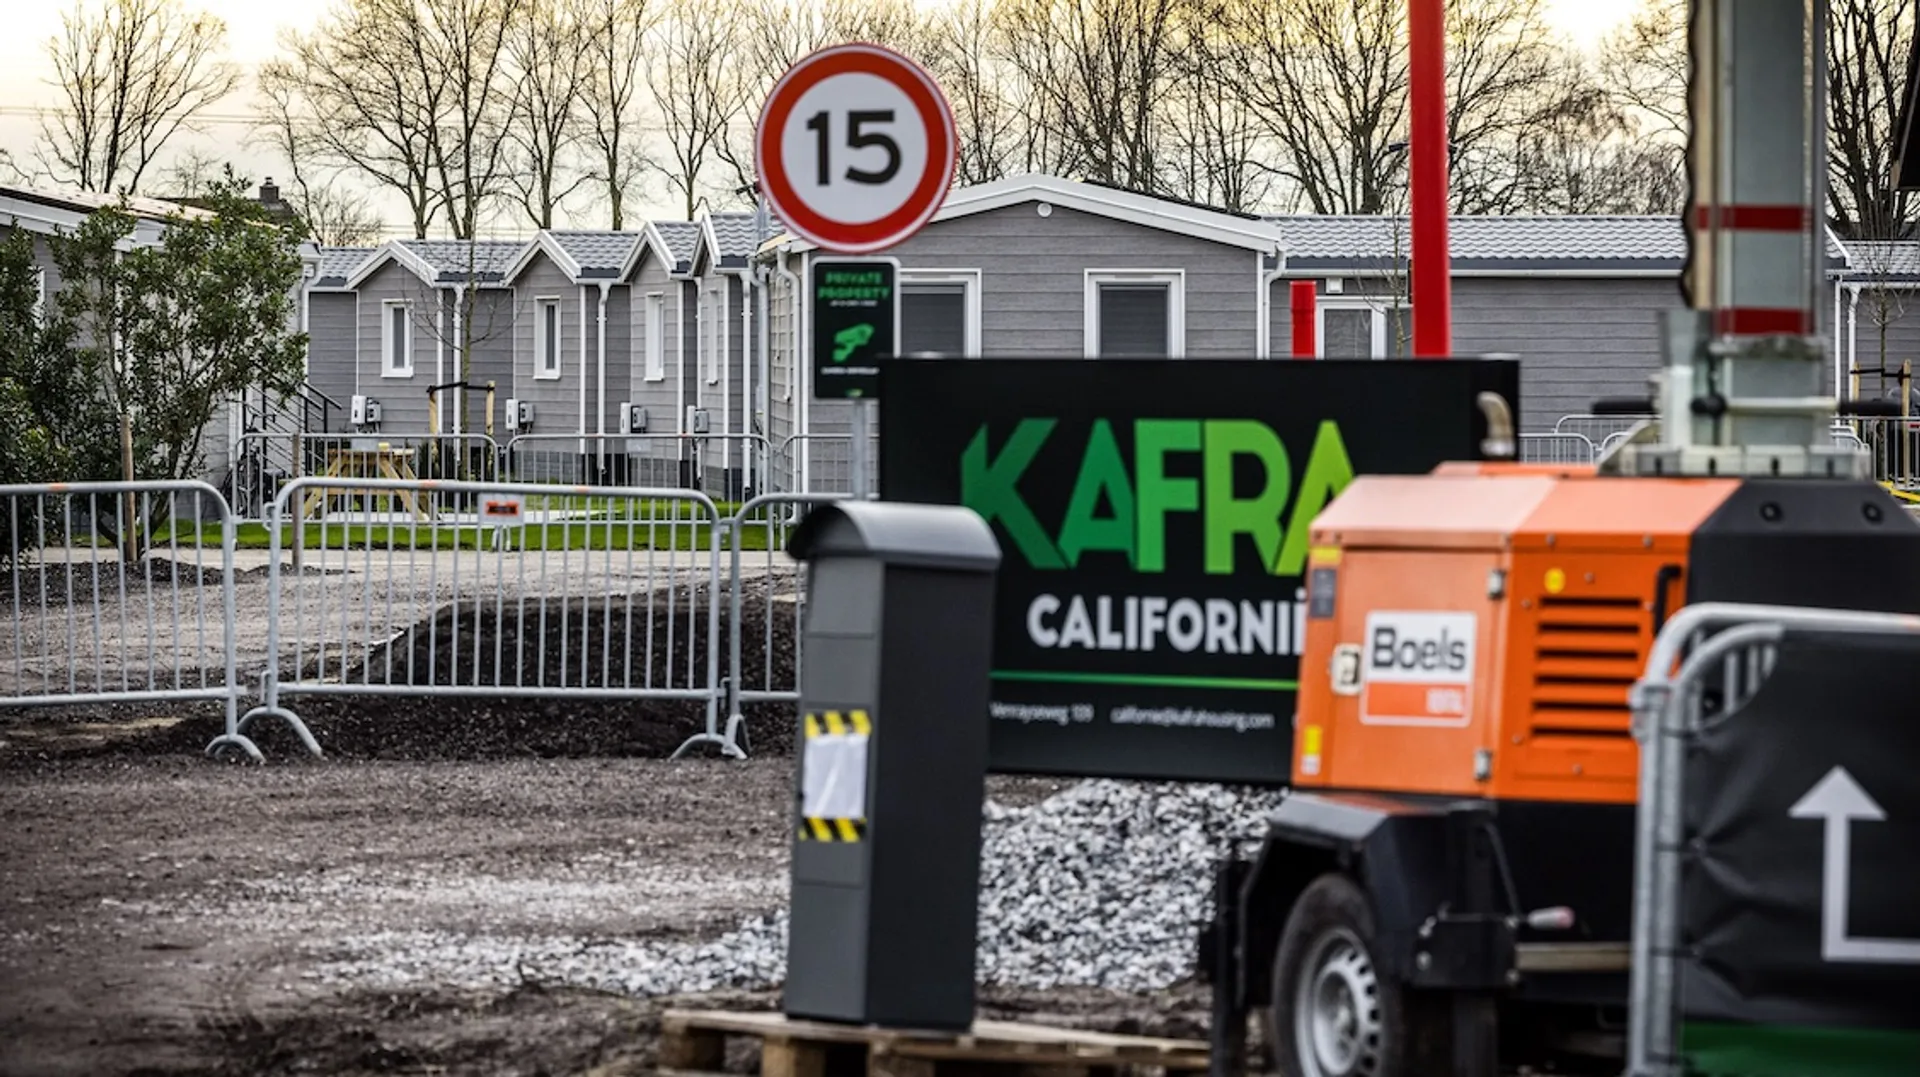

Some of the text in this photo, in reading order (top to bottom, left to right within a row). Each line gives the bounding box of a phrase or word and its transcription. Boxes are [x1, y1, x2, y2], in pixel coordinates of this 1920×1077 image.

[806, 110, 902, 185] 15
[818, 286, 888, 299] PROPERTY
[825, 271, 883, 285] PRIVATE
[961, 417, 1355, 576] KAFRA
[1373, 626, 1466, 672] Boels
